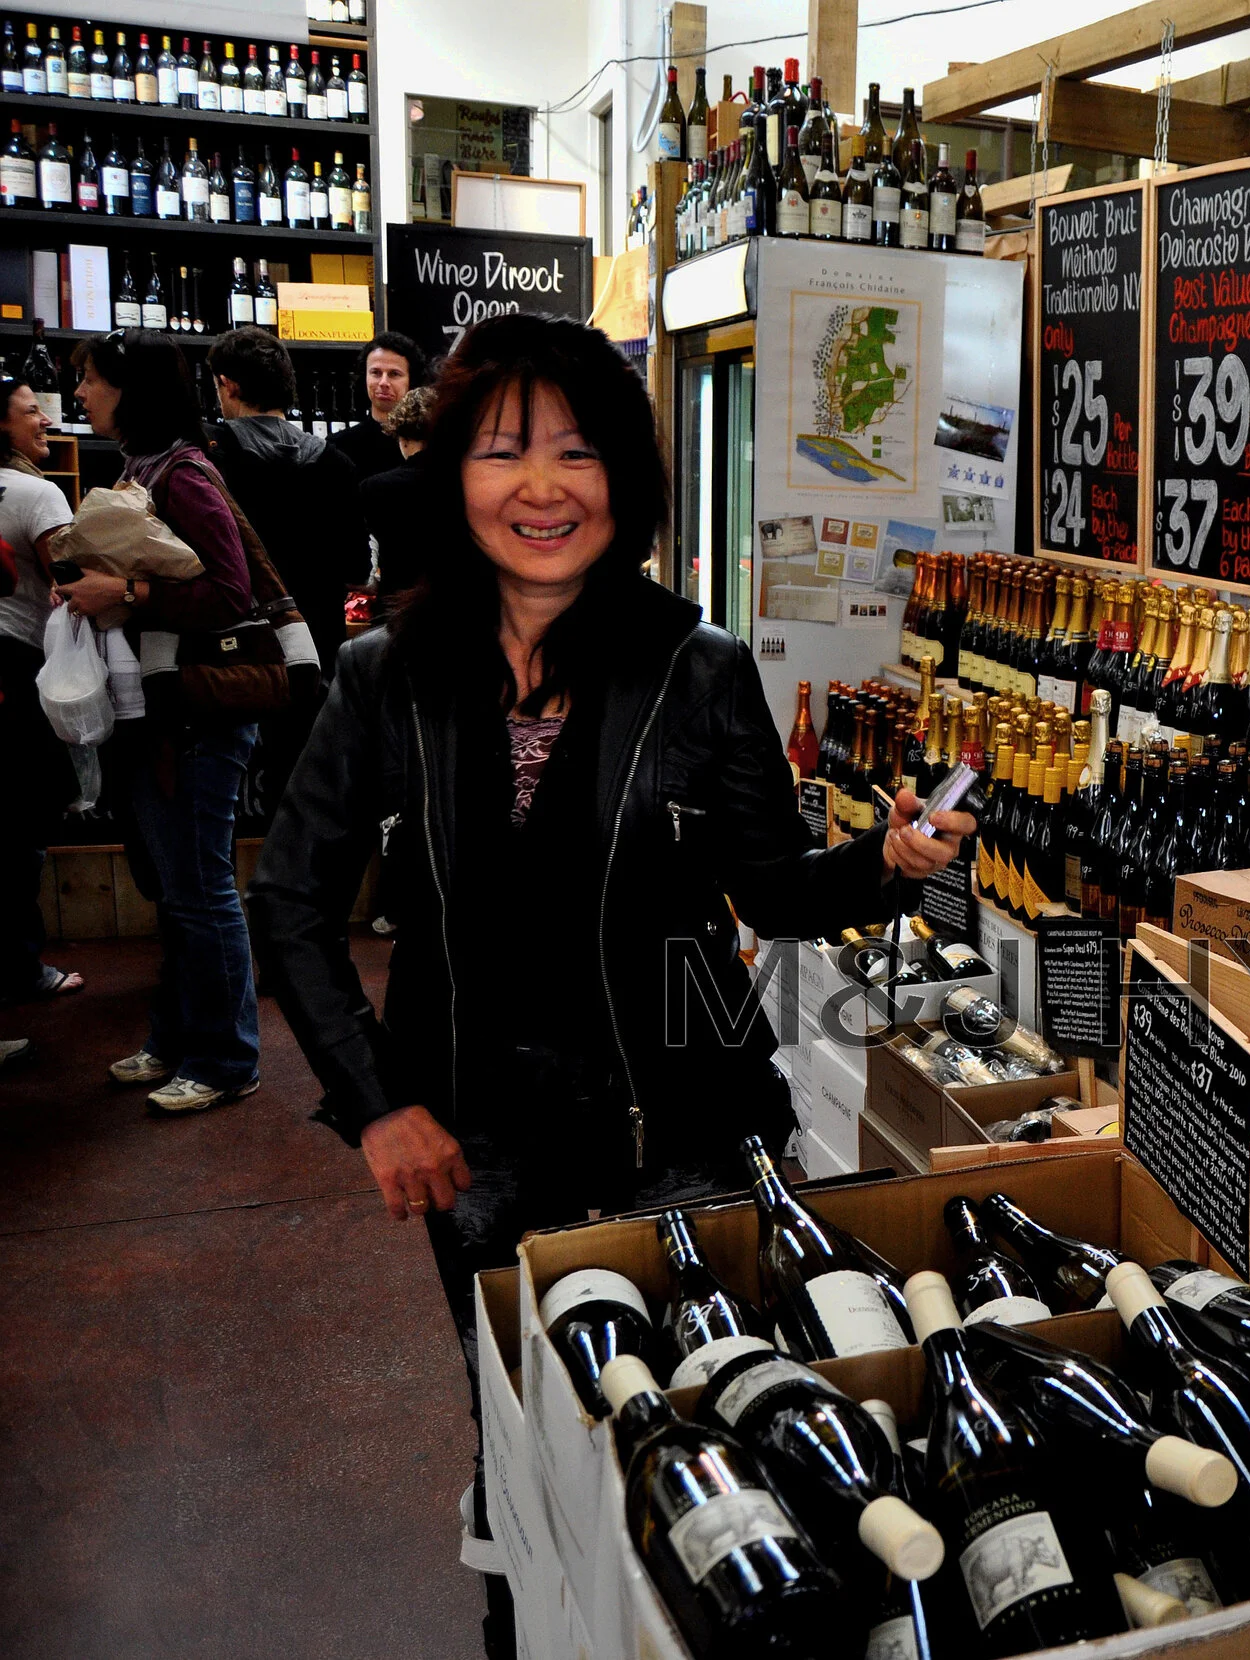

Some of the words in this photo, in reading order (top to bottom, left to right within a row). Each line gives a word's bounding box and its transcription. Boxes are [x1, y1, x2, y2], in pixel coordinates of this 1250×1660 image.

[1049, 200, 1098, 246] Bouvet
[1104, 197, 1137, 238] Brut
[1062, 238, 1117, 279] Méthode
[1160, 226, 1239, 272] Delacoste
[414, 248, 478, 288] Wine
[483, 252, 564, 293] Direct
[809, 278, 855, 291] François
[859, 281, 906, 295] Chidaine
[821, 268, 894, 282] Domaine
[1174, 272, 1207, 310] Best
[1044, 322, 1074, 358] Only
[1052, 359, 1109, 466] $25
[1113, 412, 1133, 441] Per
[1172, 353, 1250, 466] $39
[1044, 468, 1086, 547] $24
[1091, 484, 1118, 512] Each
[1107, 512, 1129, 541] the
[1156, 479, 1218, 569] $37
[1222, 526, 1238, 554] by
[1180, 904, 1229, 942] Prosecco
[1134, 1002, 1153, 1037] $39
[1190, 1060, 1213, 1094] $37
[820, 1086, 852, 1121] CHAMPAGNE
